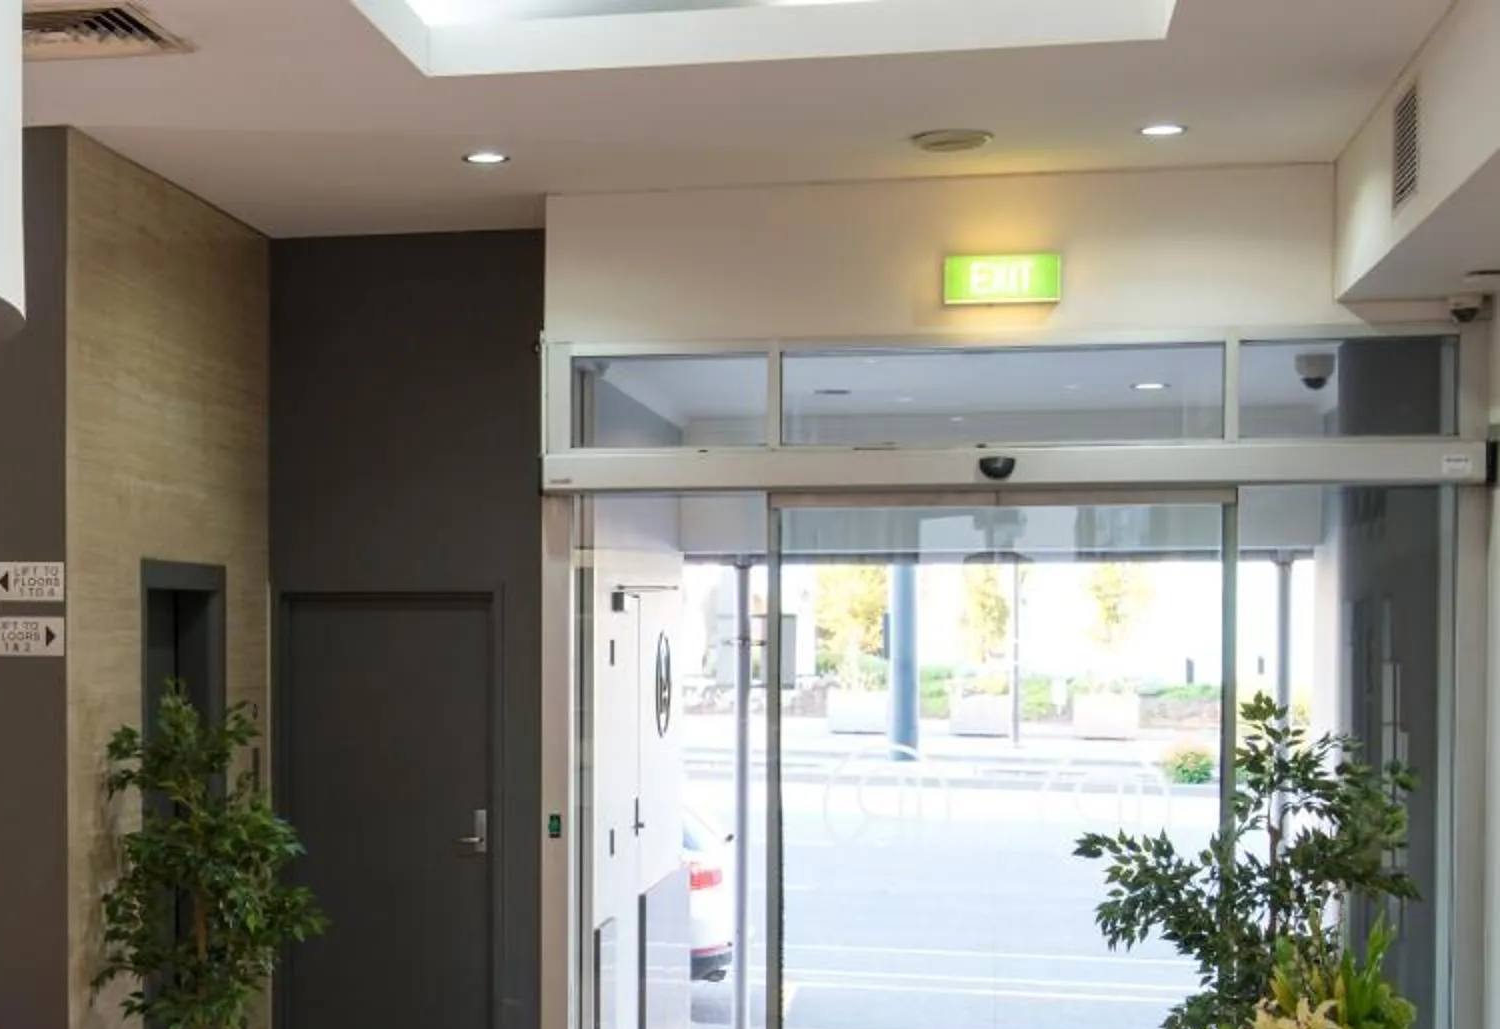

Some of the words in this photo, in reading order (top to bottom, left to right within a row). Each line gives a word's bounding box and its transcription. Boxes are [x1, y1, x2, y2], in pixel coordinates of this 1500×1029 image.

[969, 260, 1035, 295] EXIT
[43, 566, 60, 577] TO
[13, 577, 61, 587] FLOORS
[28, 587, 45, 597] TO
[23, 621, 39, 631] TO
